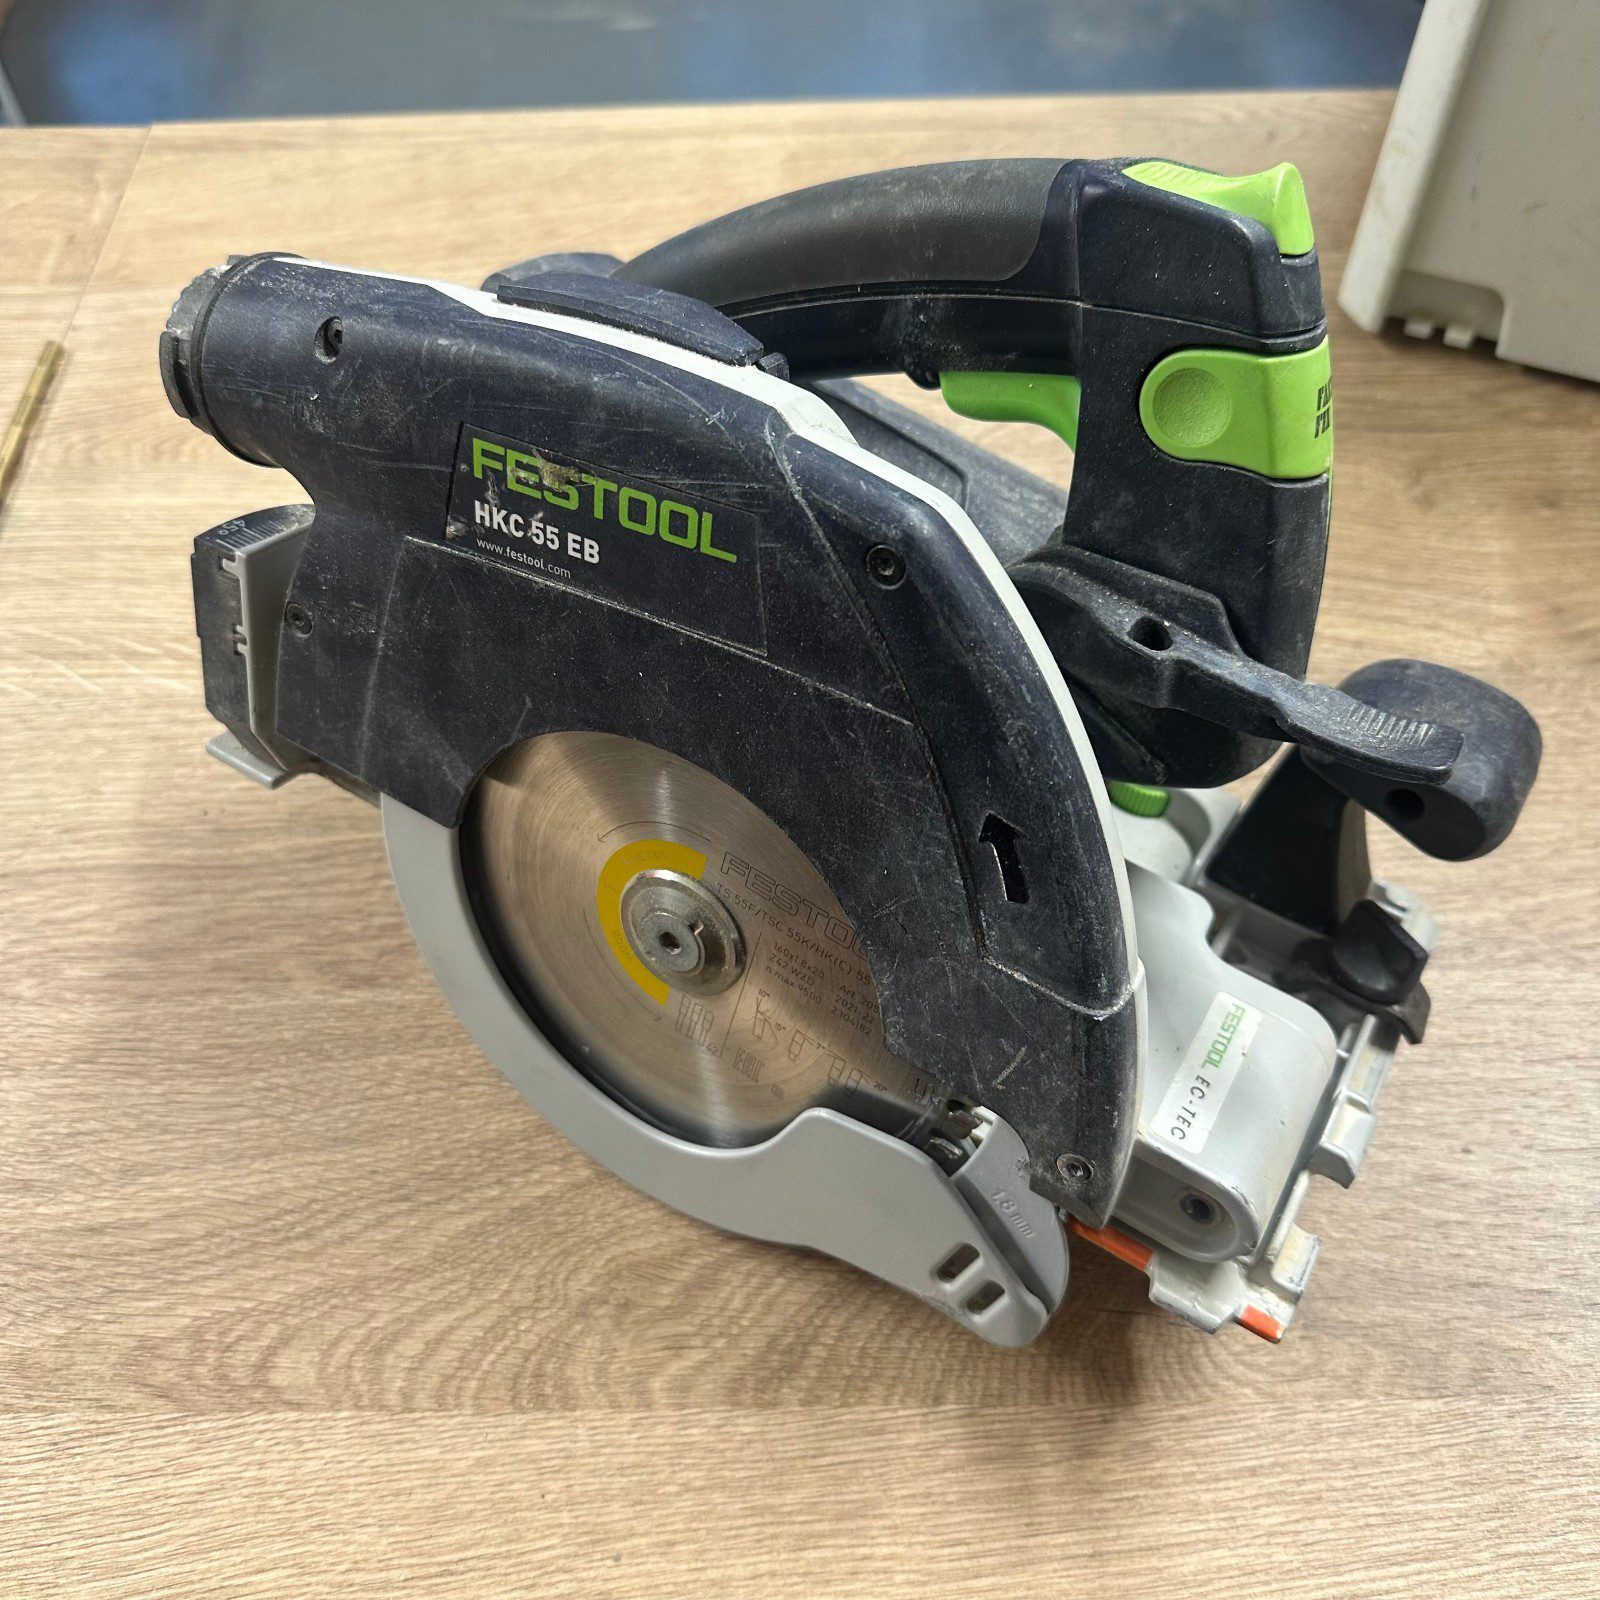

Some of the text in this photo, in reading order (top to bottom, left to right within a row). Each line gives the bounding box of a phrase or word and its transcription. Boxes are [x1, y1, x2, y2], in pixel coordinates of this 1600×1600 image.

[472, 437, 738, 564] FESTOOL
[474, 500, 600, 564] HKC 55 EB
[476, 537, 572, 580] www.festool.com
[720, 851, 868, 961] FESTO
[1170, 1003, 1246, 1140] FESTOOL EC-TEC
